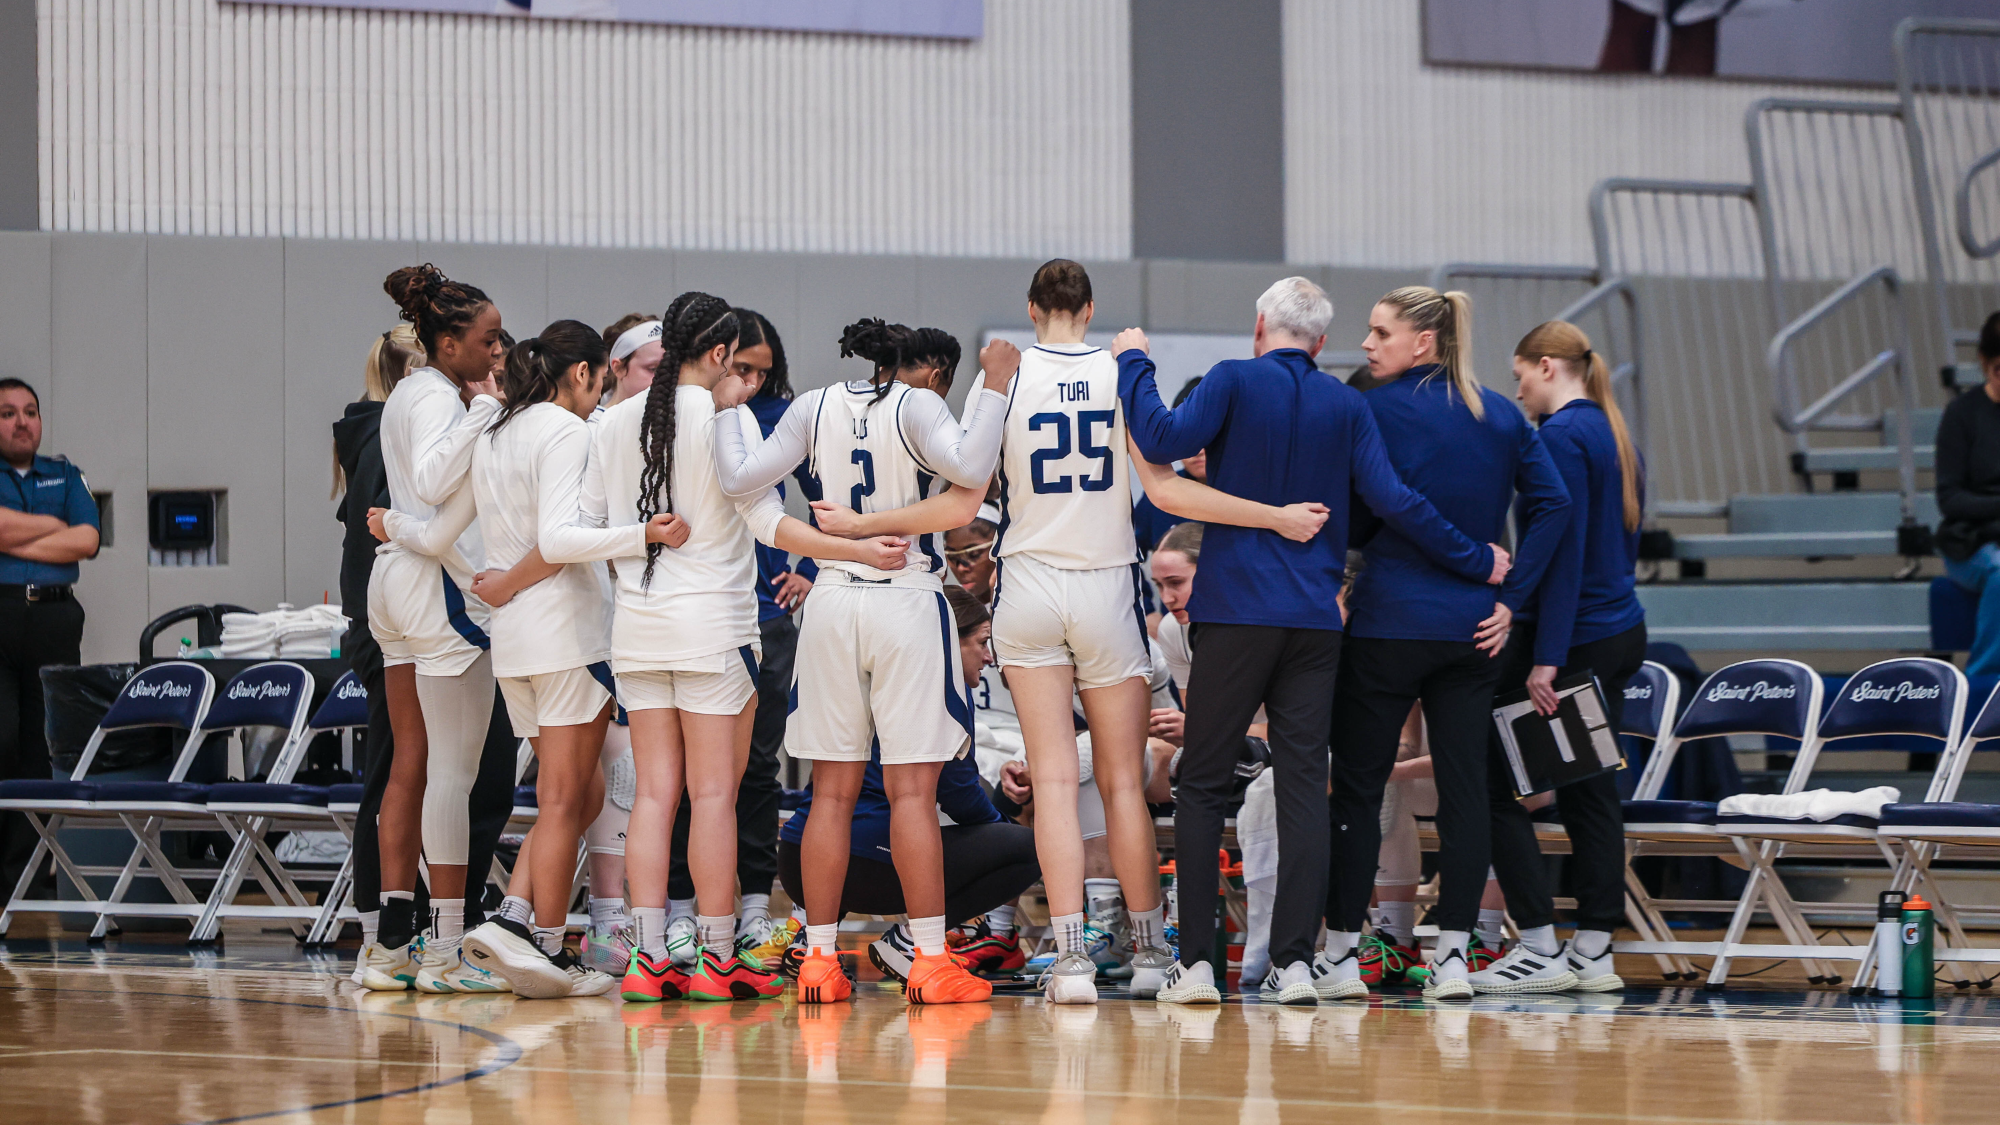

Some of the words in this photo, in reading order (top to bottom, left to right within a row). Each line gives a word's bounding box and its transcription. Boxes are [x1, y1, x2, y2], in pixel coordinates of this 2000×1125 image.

[1057, 381, 1090, 403] TURI
[1028, 408, 1116, 494] 25
[128, 680, 161, 699] Saint
[227, 680, 261, 700] Saint
[1705, 681, 1752, 702] Saint
[1748, 681, 1797, 702] Peter's
[1849, 681, 1896, 702] Saint
[1893, 681, 1941, 703] Peter's
[1902, 922, 1920, 945] G
